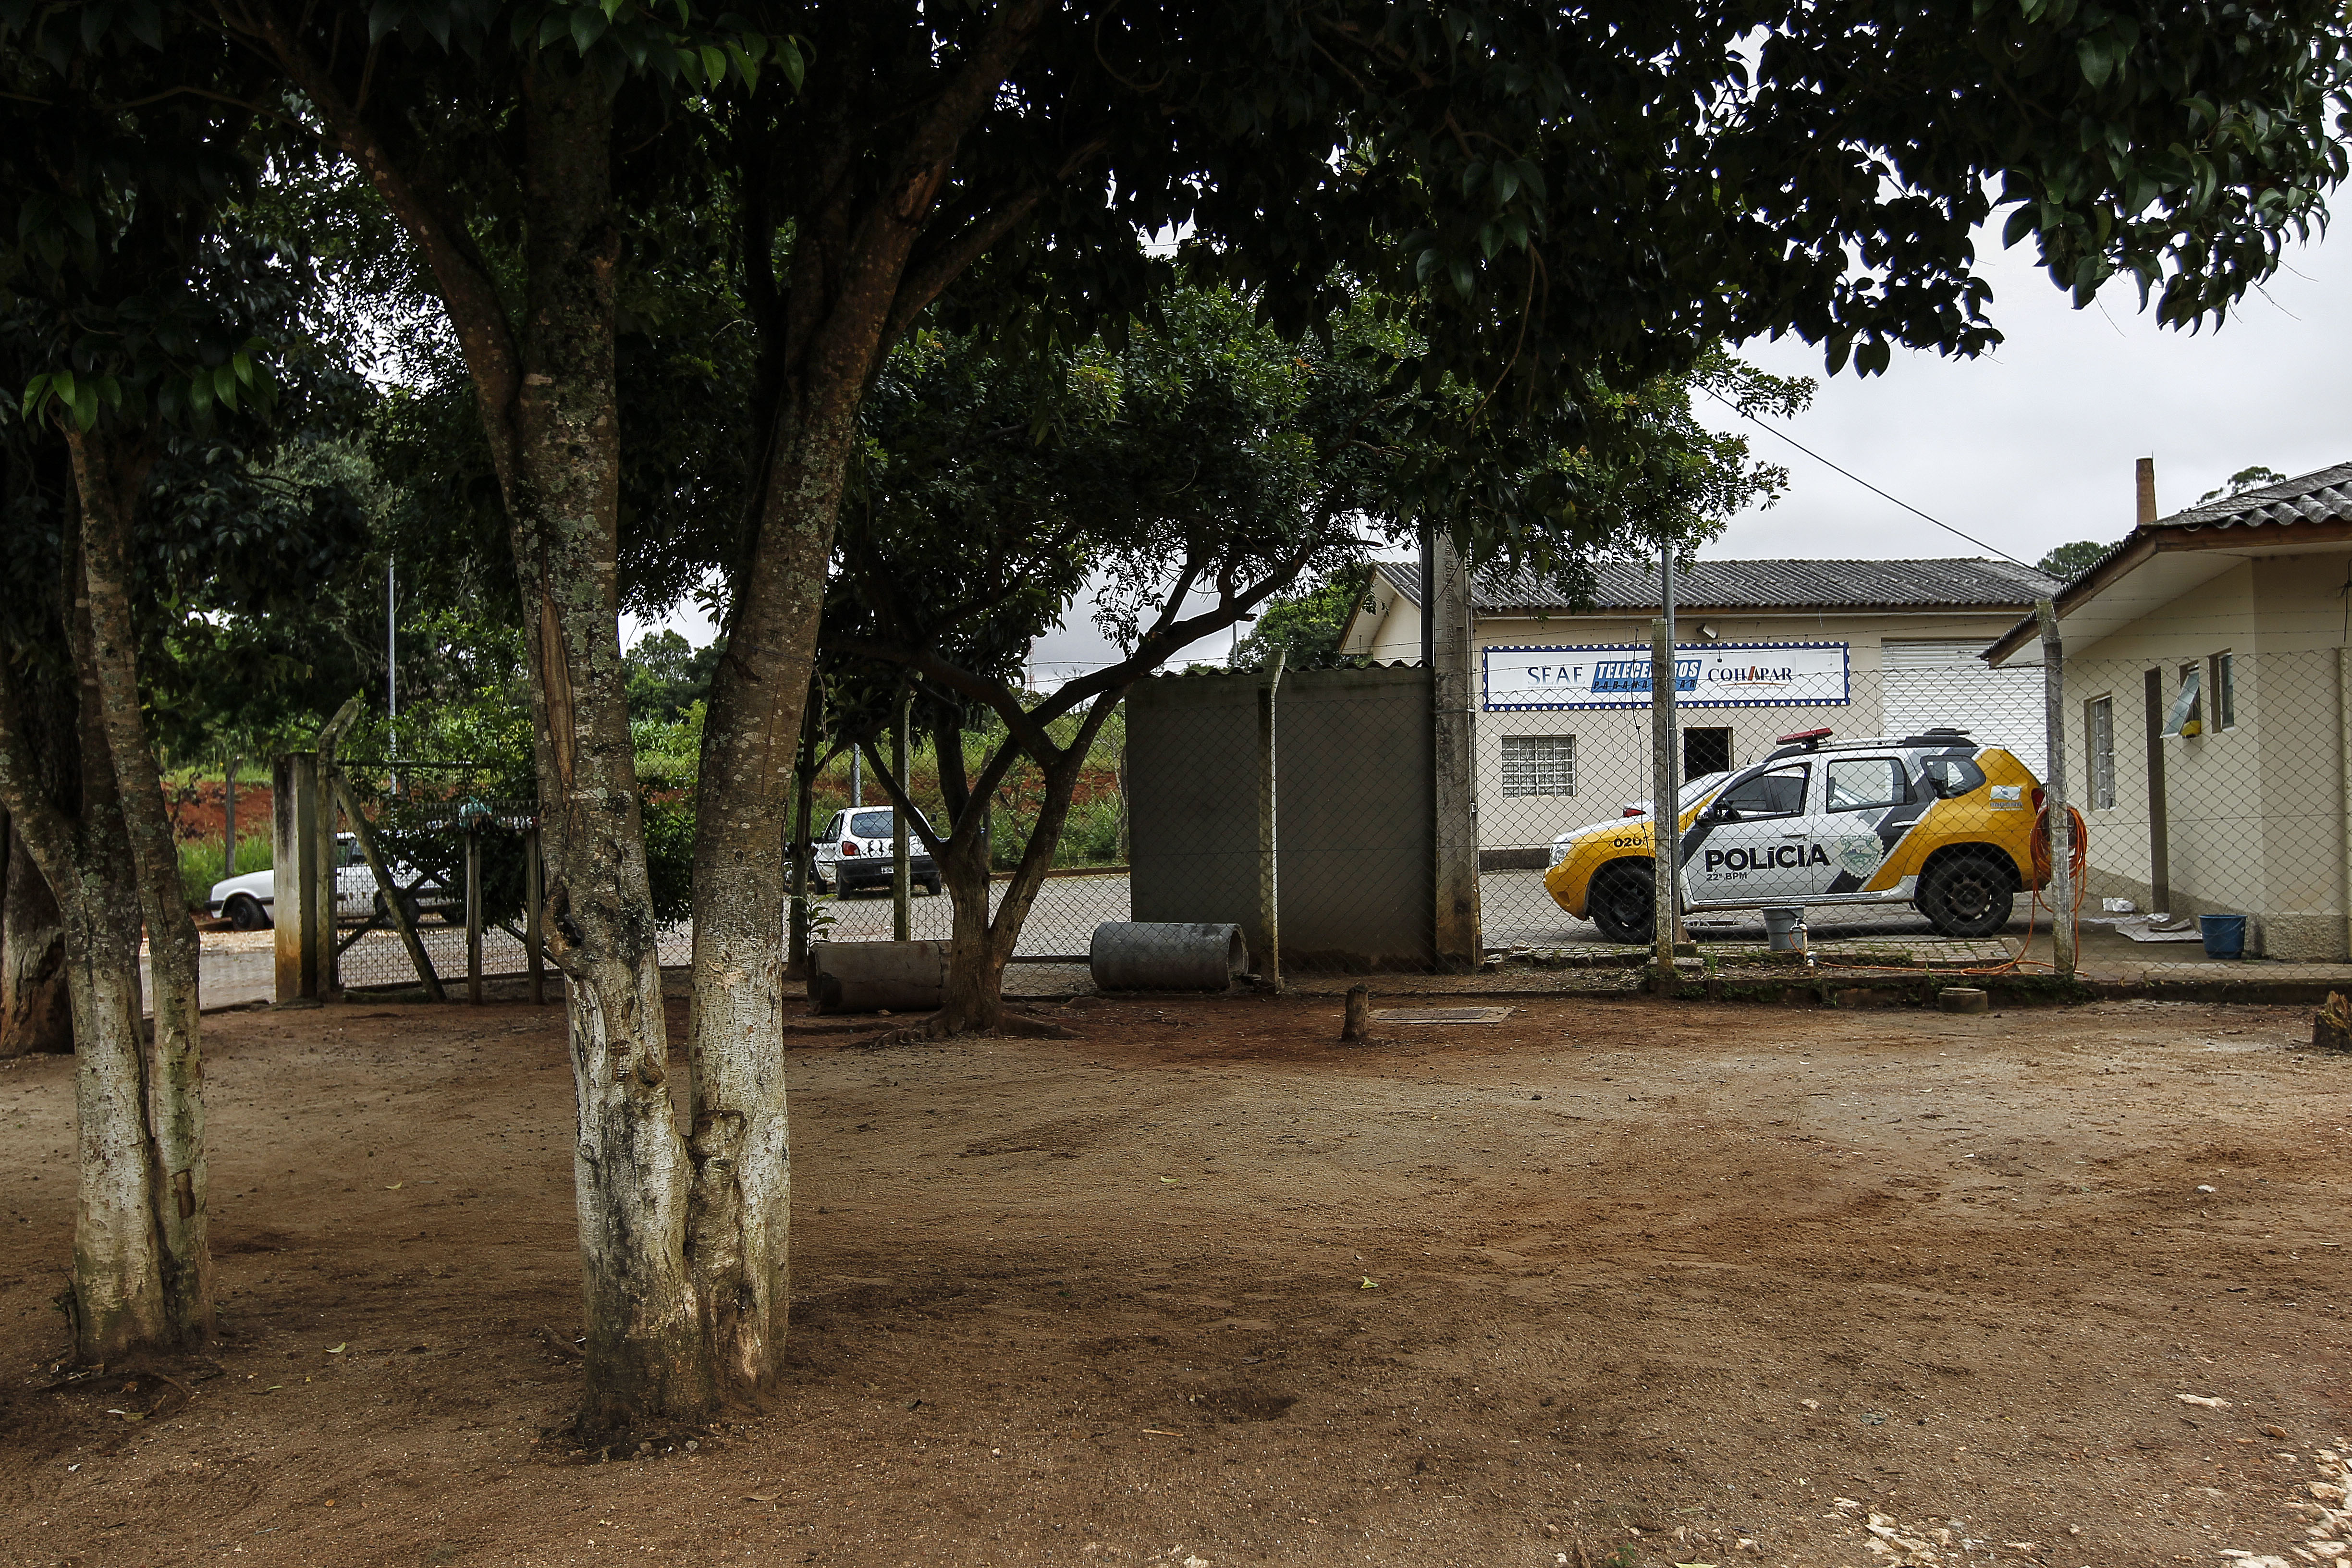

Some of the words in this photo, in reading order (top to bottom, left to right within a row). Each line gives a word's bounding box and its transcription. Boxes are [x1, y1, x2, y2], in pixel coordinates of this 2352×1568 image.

[1598, 662, 1700, 679] TELECEOS
[1708, 666, 1792, 682] COHAPAR
[1593, 679, 1695, 689] PARANAAR
[1705, 844, 1831, 872] POLÍCIA
[1725, 871, 1747, 880] BPM
